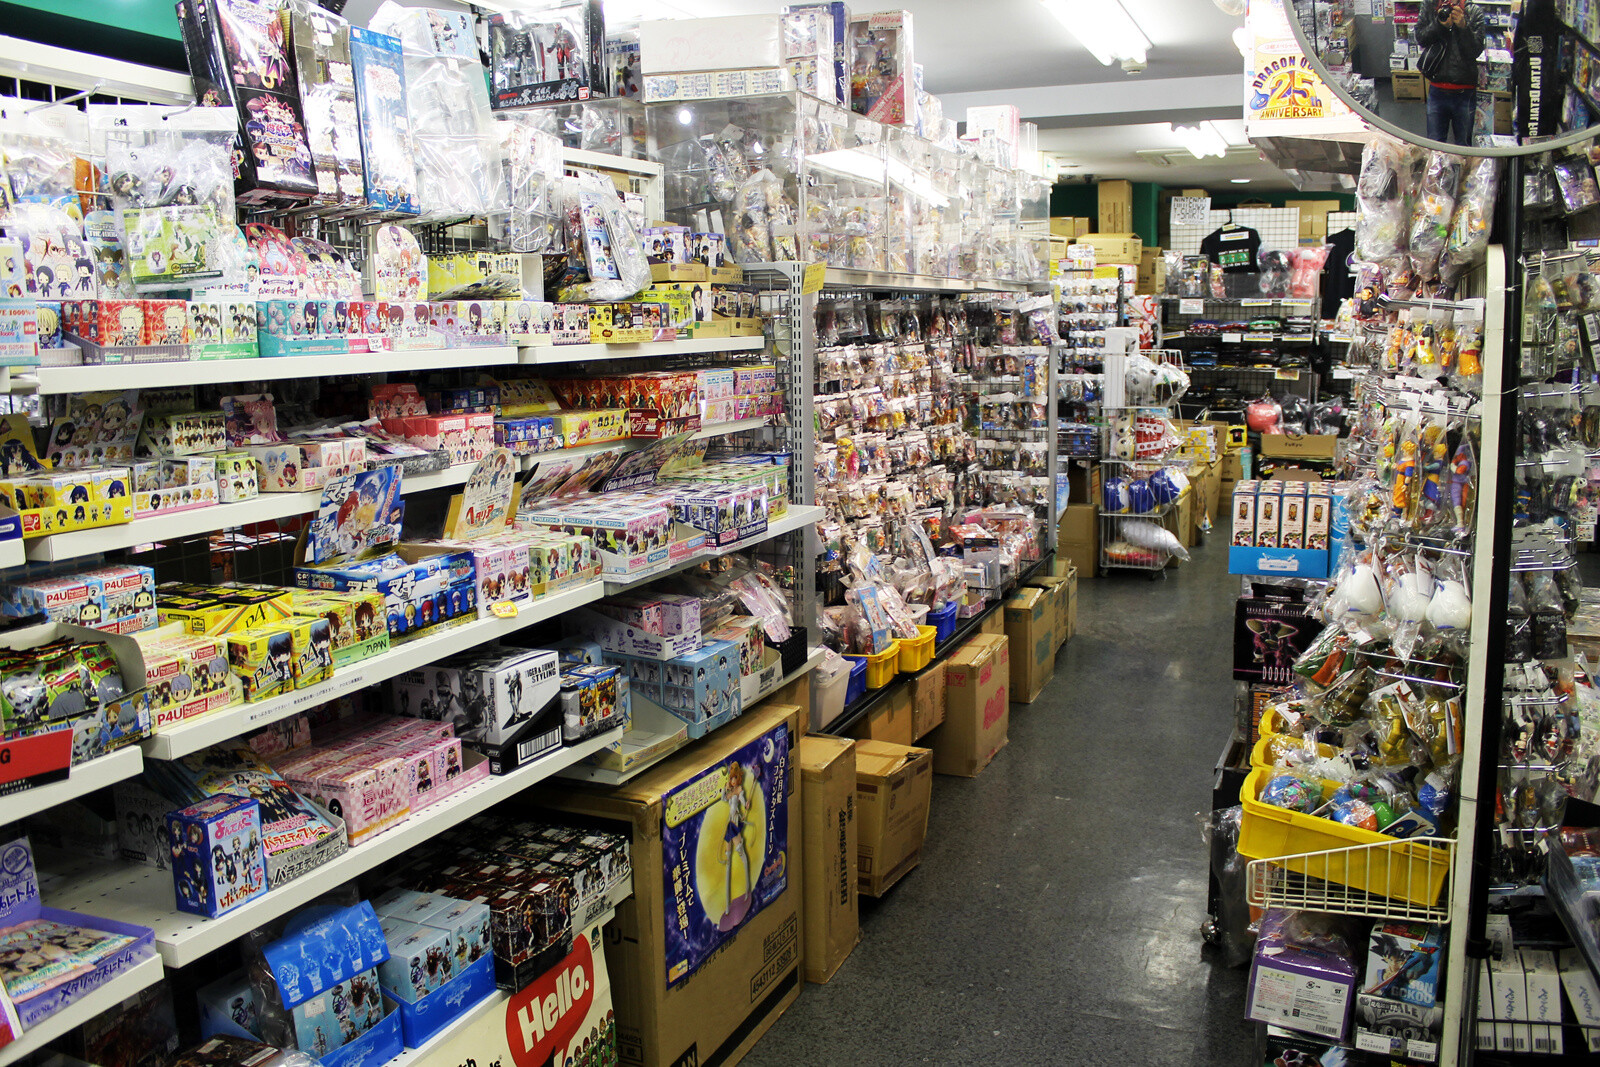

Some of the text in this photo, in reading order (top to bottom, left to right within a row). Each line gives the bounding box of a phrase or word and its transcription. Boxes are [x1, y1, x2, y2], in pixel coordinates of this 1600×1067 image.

[1252, 56, 1296, 89] DRAGON
[1260, 106, 1323, 119] ANNIVERSARY
[105, 579, 123, 590] P4U
[47, 592, 67, 604] P4U
[532, 668, 556, 684] STYLING
[158, 708, 183, 726] P4U
[678, 790, 718, 821] ファンタズムーン
[274, 840, 346, 884] バラエティプレート
[517, 964, 590, 1054] Hello.
